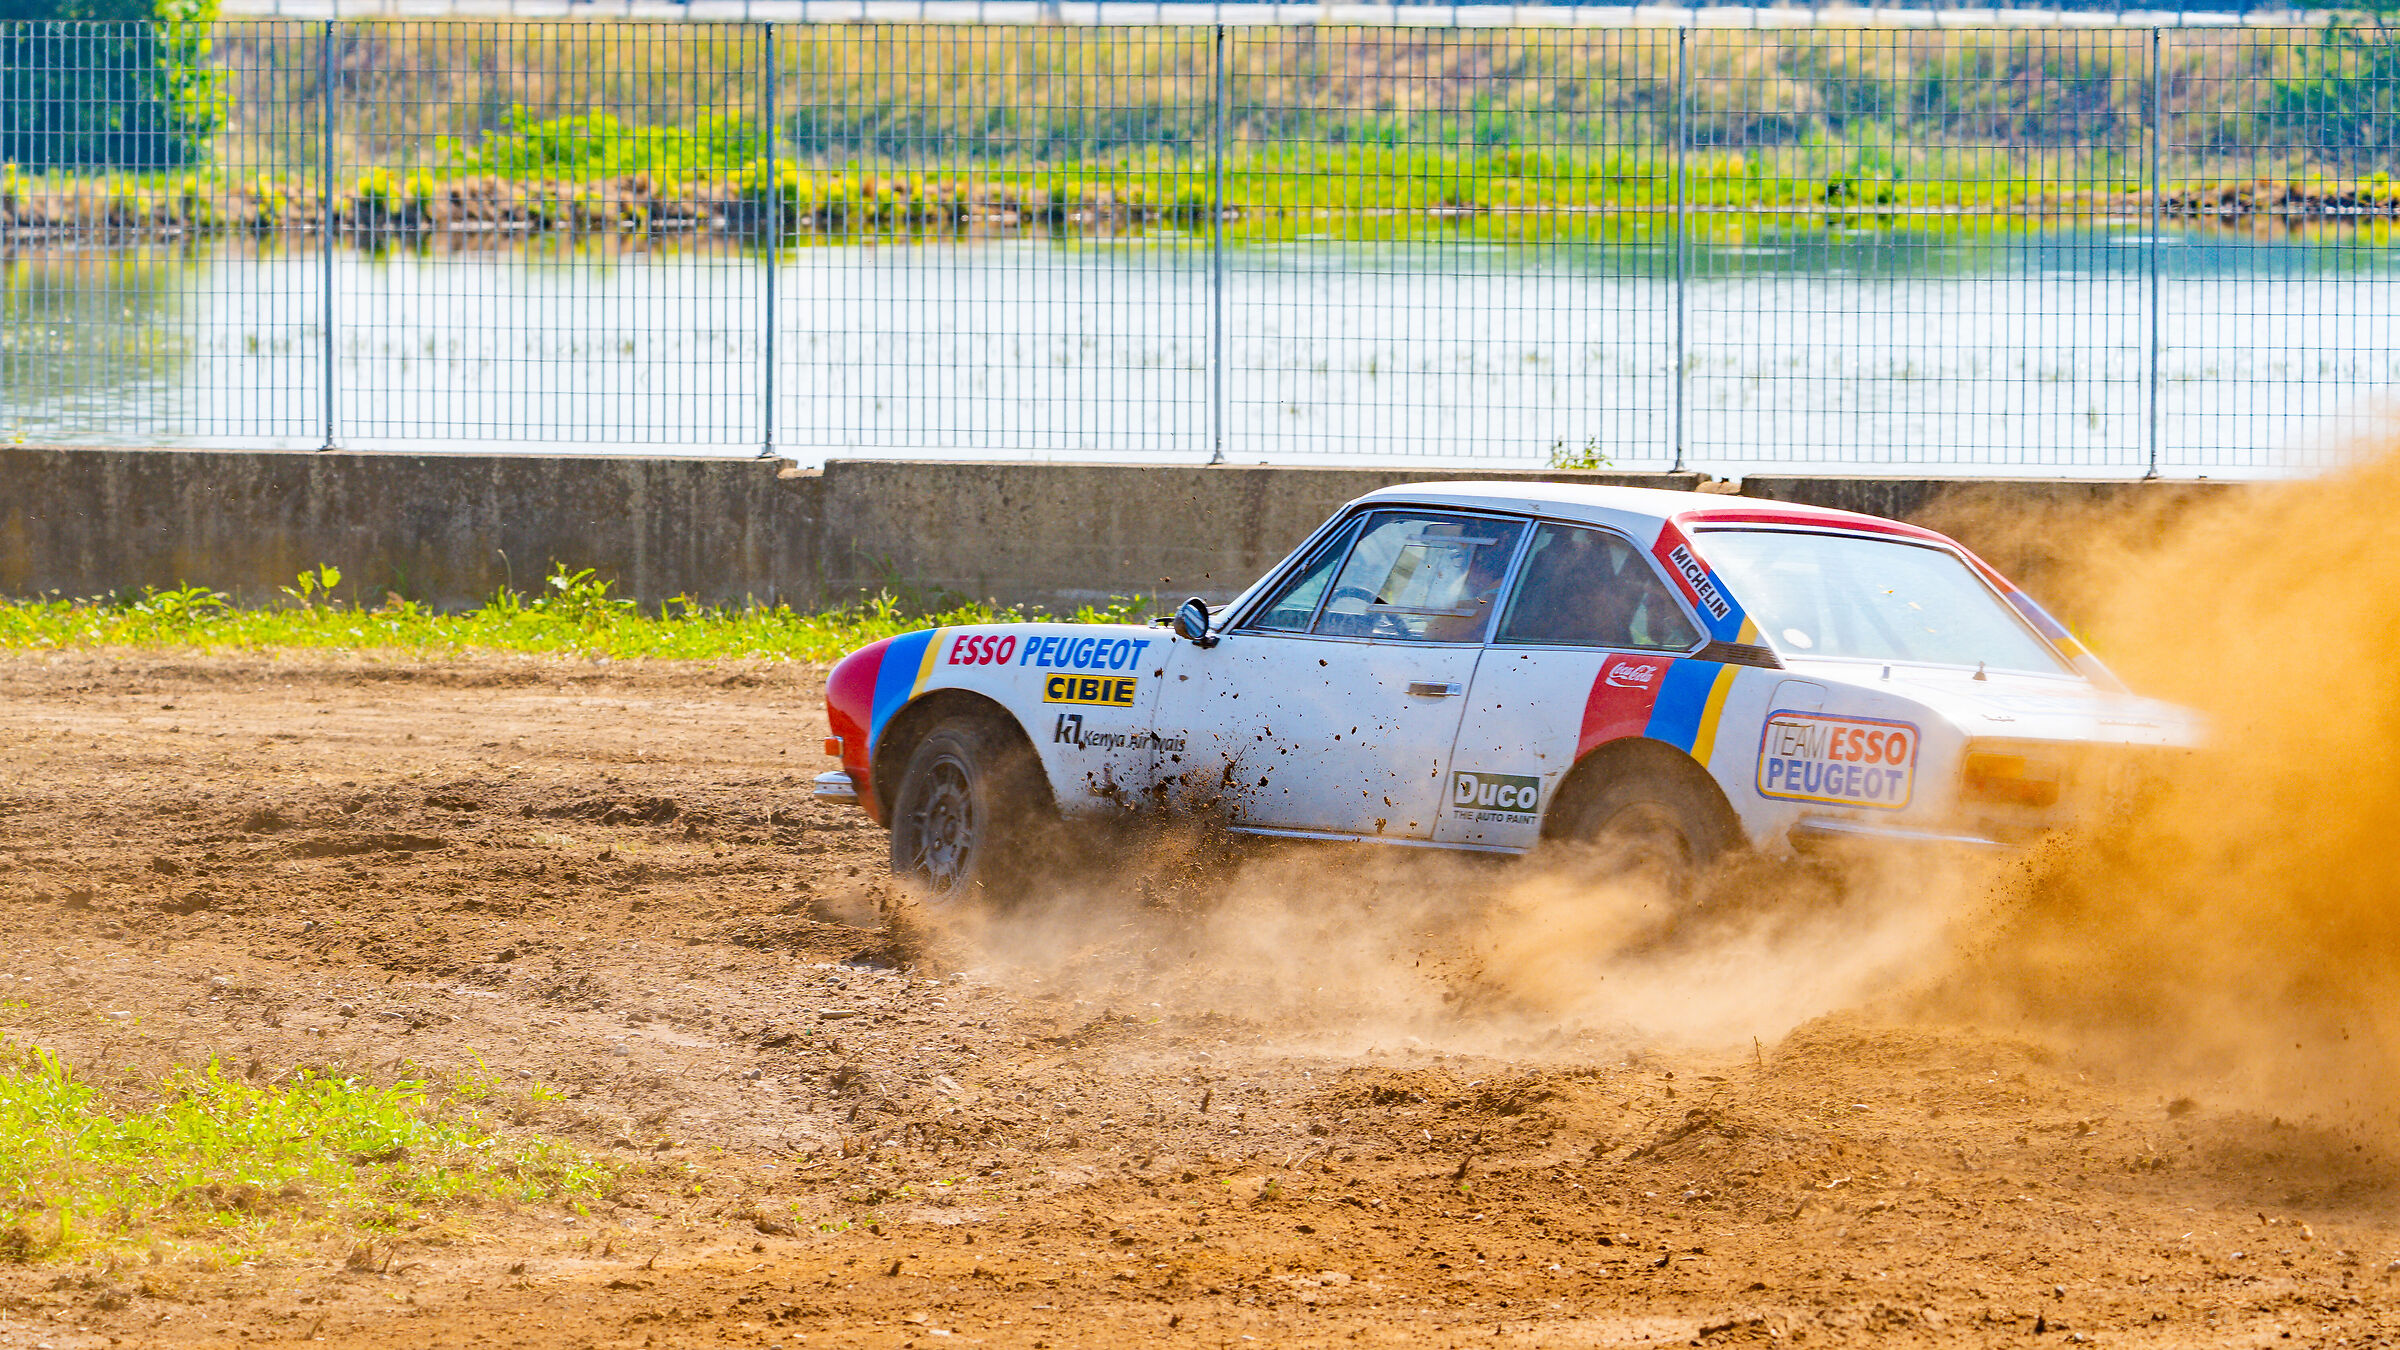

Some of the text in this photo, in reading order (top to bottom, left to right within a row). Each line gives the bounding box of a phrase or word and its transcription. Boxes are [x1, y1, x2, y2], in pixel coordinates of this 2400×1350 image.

[1672, 546, 1728, 618] MICHELIN
[948, 635, 1150, 670] ESSO PEUGEOT
[1083, 730, 1126, 752] Kenya
[1769, 722, 1907, 766] TEAM ESSO
[1455, 774, 1537, 809] Duco
[1767, 758, 1903, 800] PEUGEOT
[1453, 810, 1536, 825] THE AUTO PAINT
